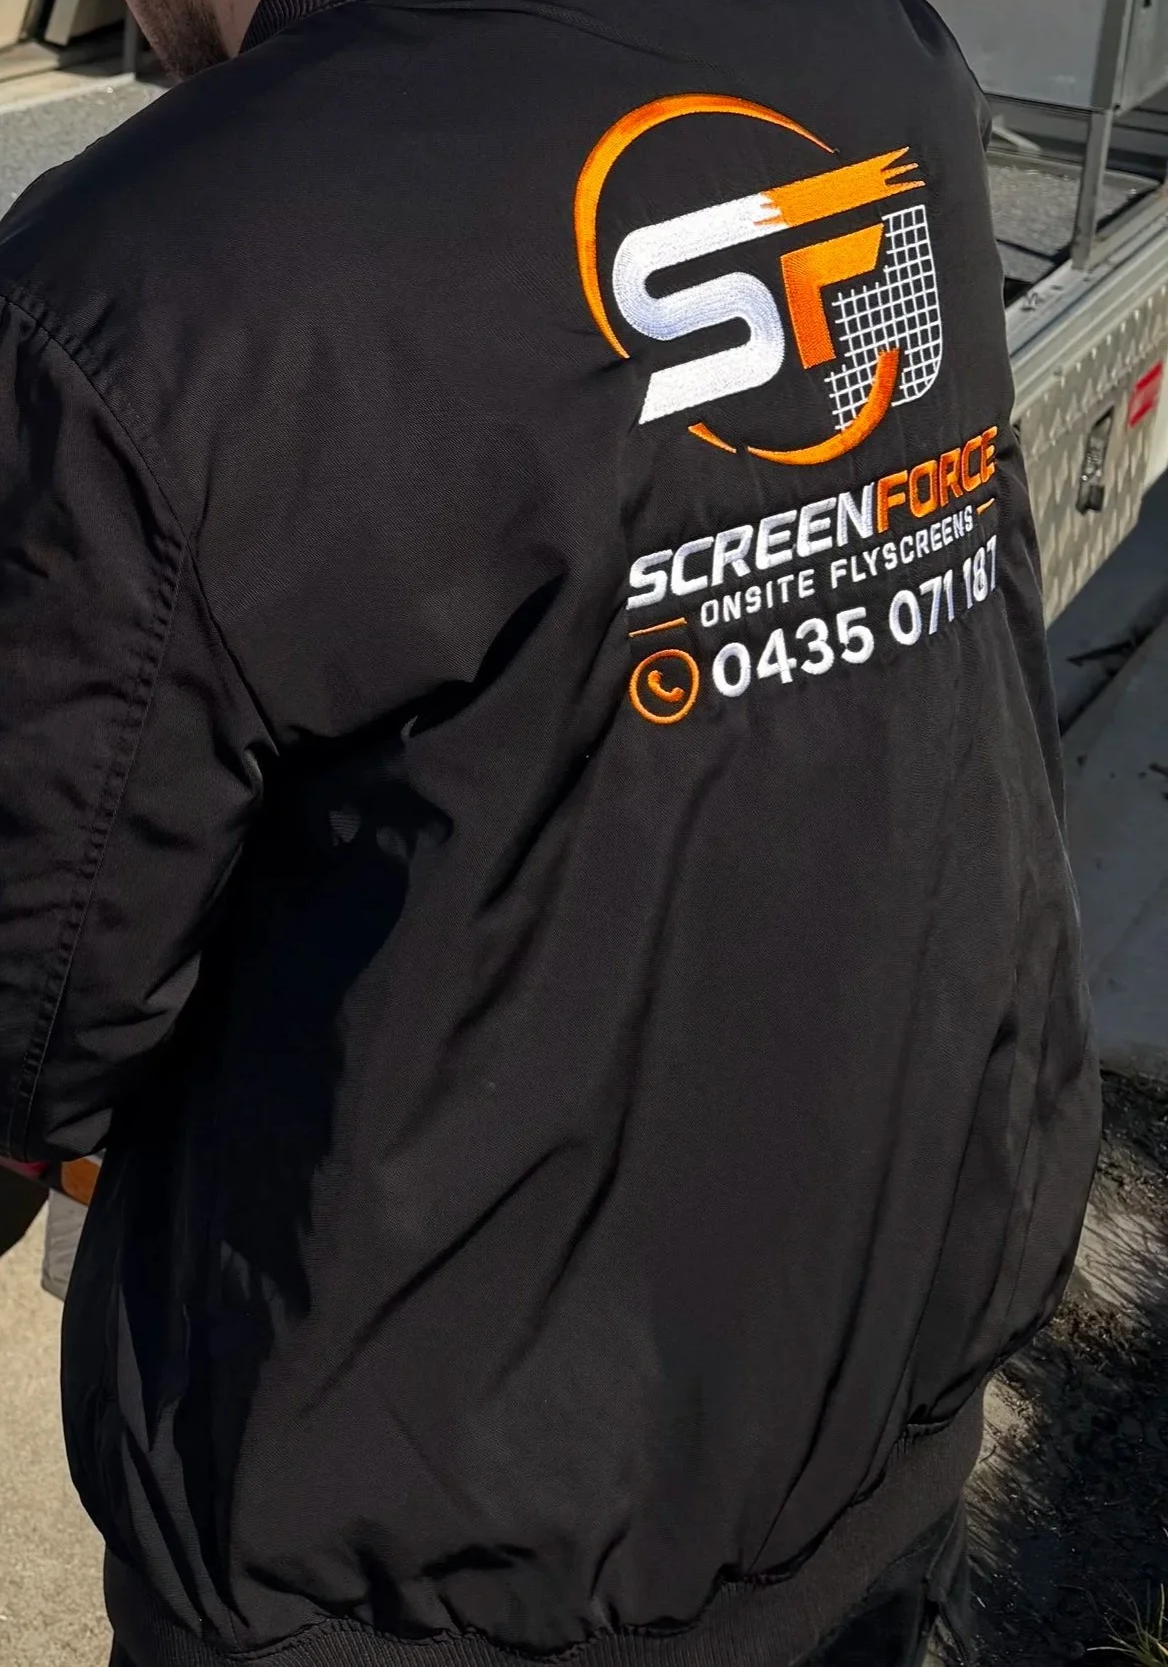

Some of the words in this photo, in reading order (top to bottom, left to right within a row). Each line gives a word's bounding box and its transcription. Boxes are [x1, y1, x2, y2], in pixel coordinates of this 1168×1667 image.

[626, 426, 998, 611] SCREENFORCE
[700, 568, 816, 628] ONSITE
[830, 504, 974, 589] FLYSCREENS
[712, 606, 876, 698] 0435
[888, 568, 955, 646] 071
[962, 534, 998, 609] 187
